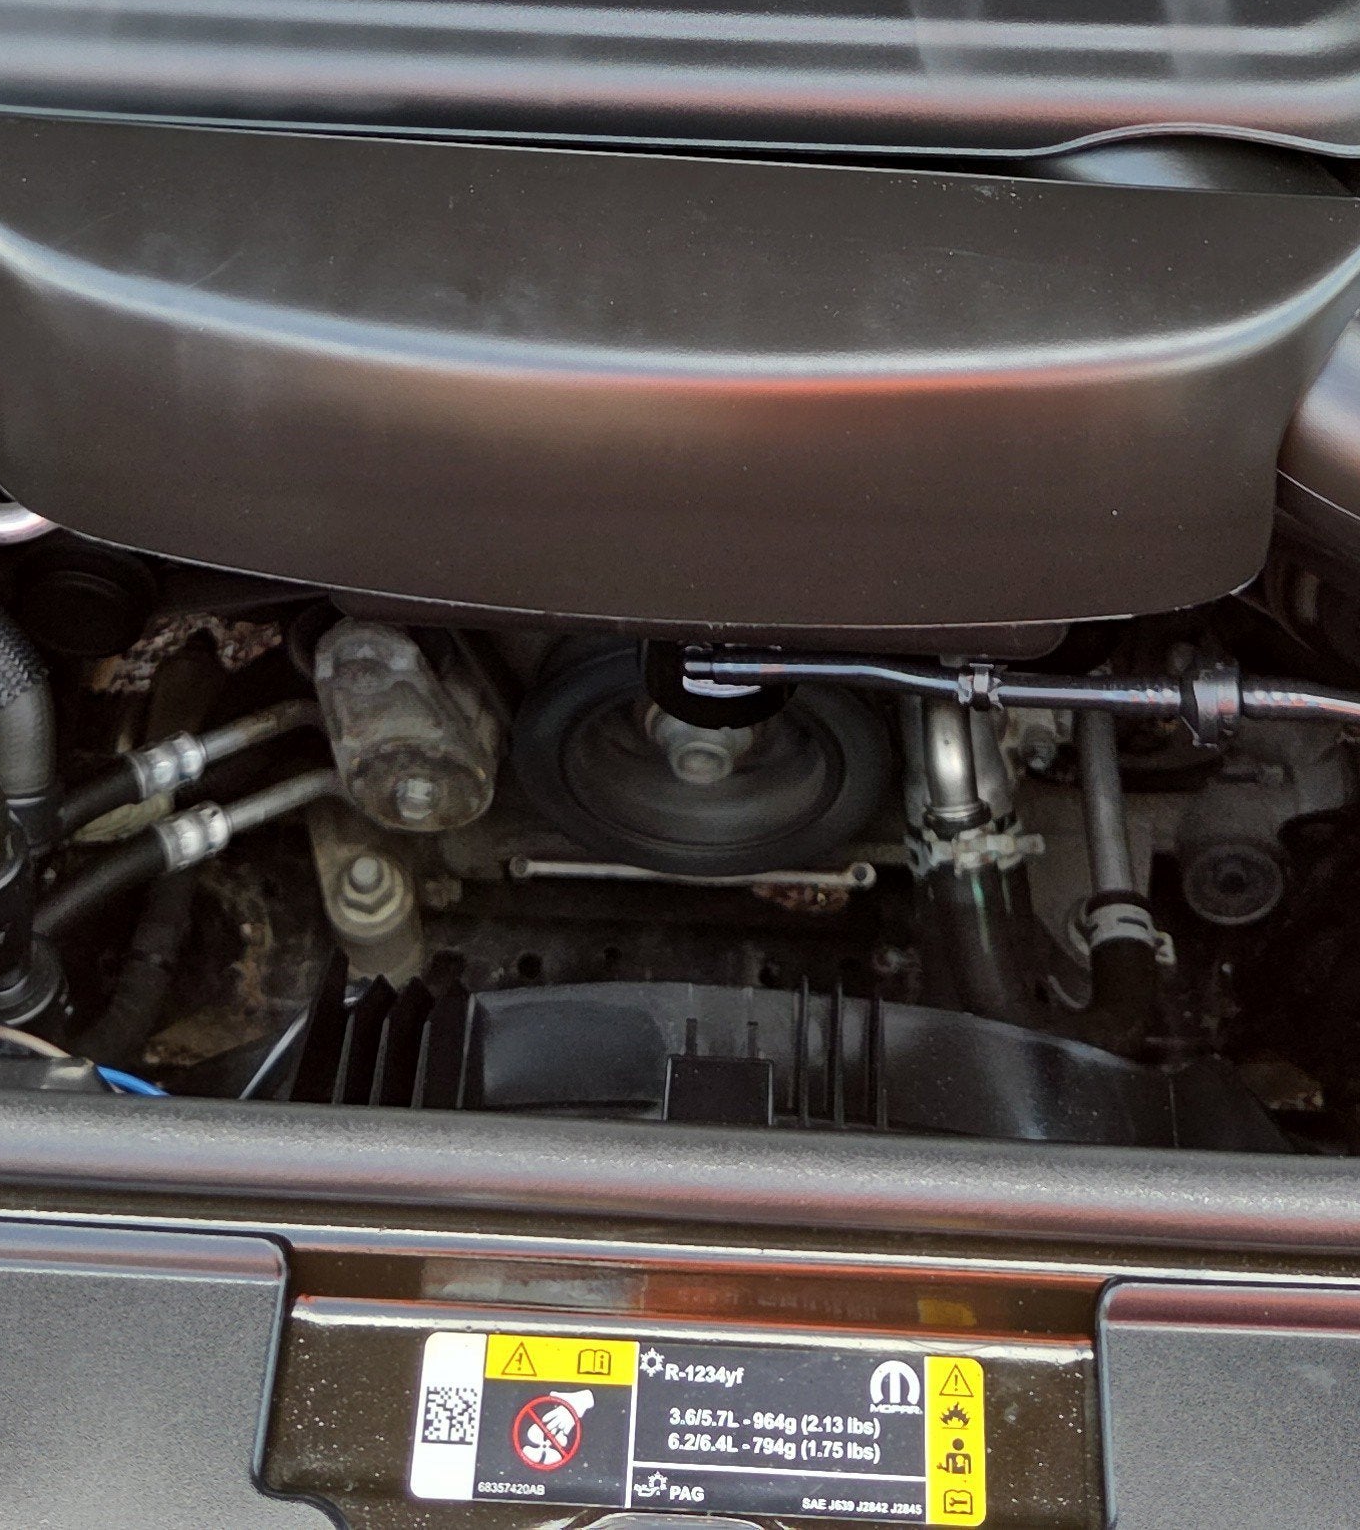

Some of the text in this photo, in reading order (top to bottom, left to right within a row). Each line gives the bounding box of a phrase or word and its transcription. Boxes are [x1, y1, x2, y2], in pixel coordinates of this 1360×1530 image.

[664, 1363, 745, 1388] R-1234yf
[669, 1407, 740, 1428] 3.6/5.7L
[753, 1411, 797, 1435] 964g
[801, 1414, 844, 1435] (2.13
[847, 1416, 881, 1440] lbs)
[668, 1432, 739, 1453] 6.2/6.4L
[753, 1436, 797, 1460] 794g
[801, 1439, 844, 1461] (1.75
[847, 1441, 881, 1465] lbs)
[669, 1485, 705, 1502] PAG
[802, 1497, 827, 1510] SAE
